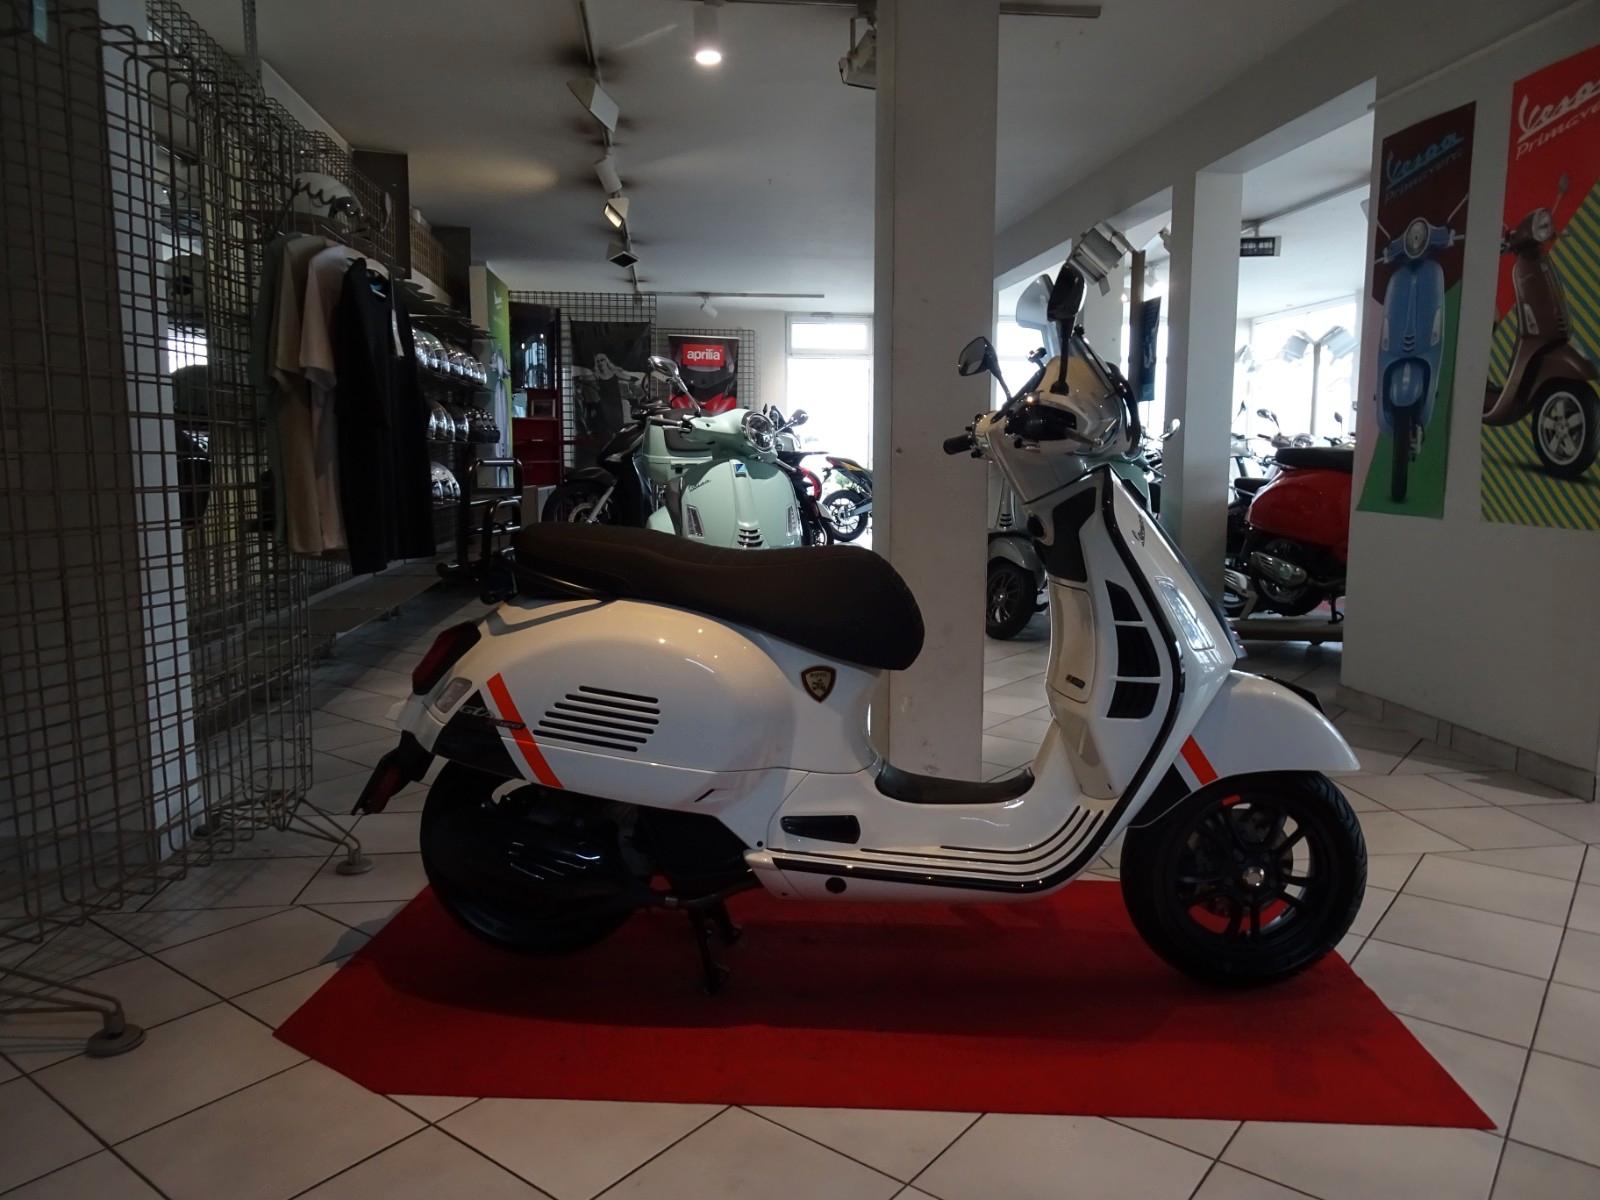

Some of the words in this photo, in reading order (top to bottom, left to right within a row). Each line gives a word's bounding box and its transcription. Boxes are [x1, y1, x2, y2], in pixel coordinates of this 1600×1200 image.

[1517, 79, 1600, 144] Vesp
[1385, 132, 1464, 190] Vespa
[687, 348, 720, 362] aprilia
